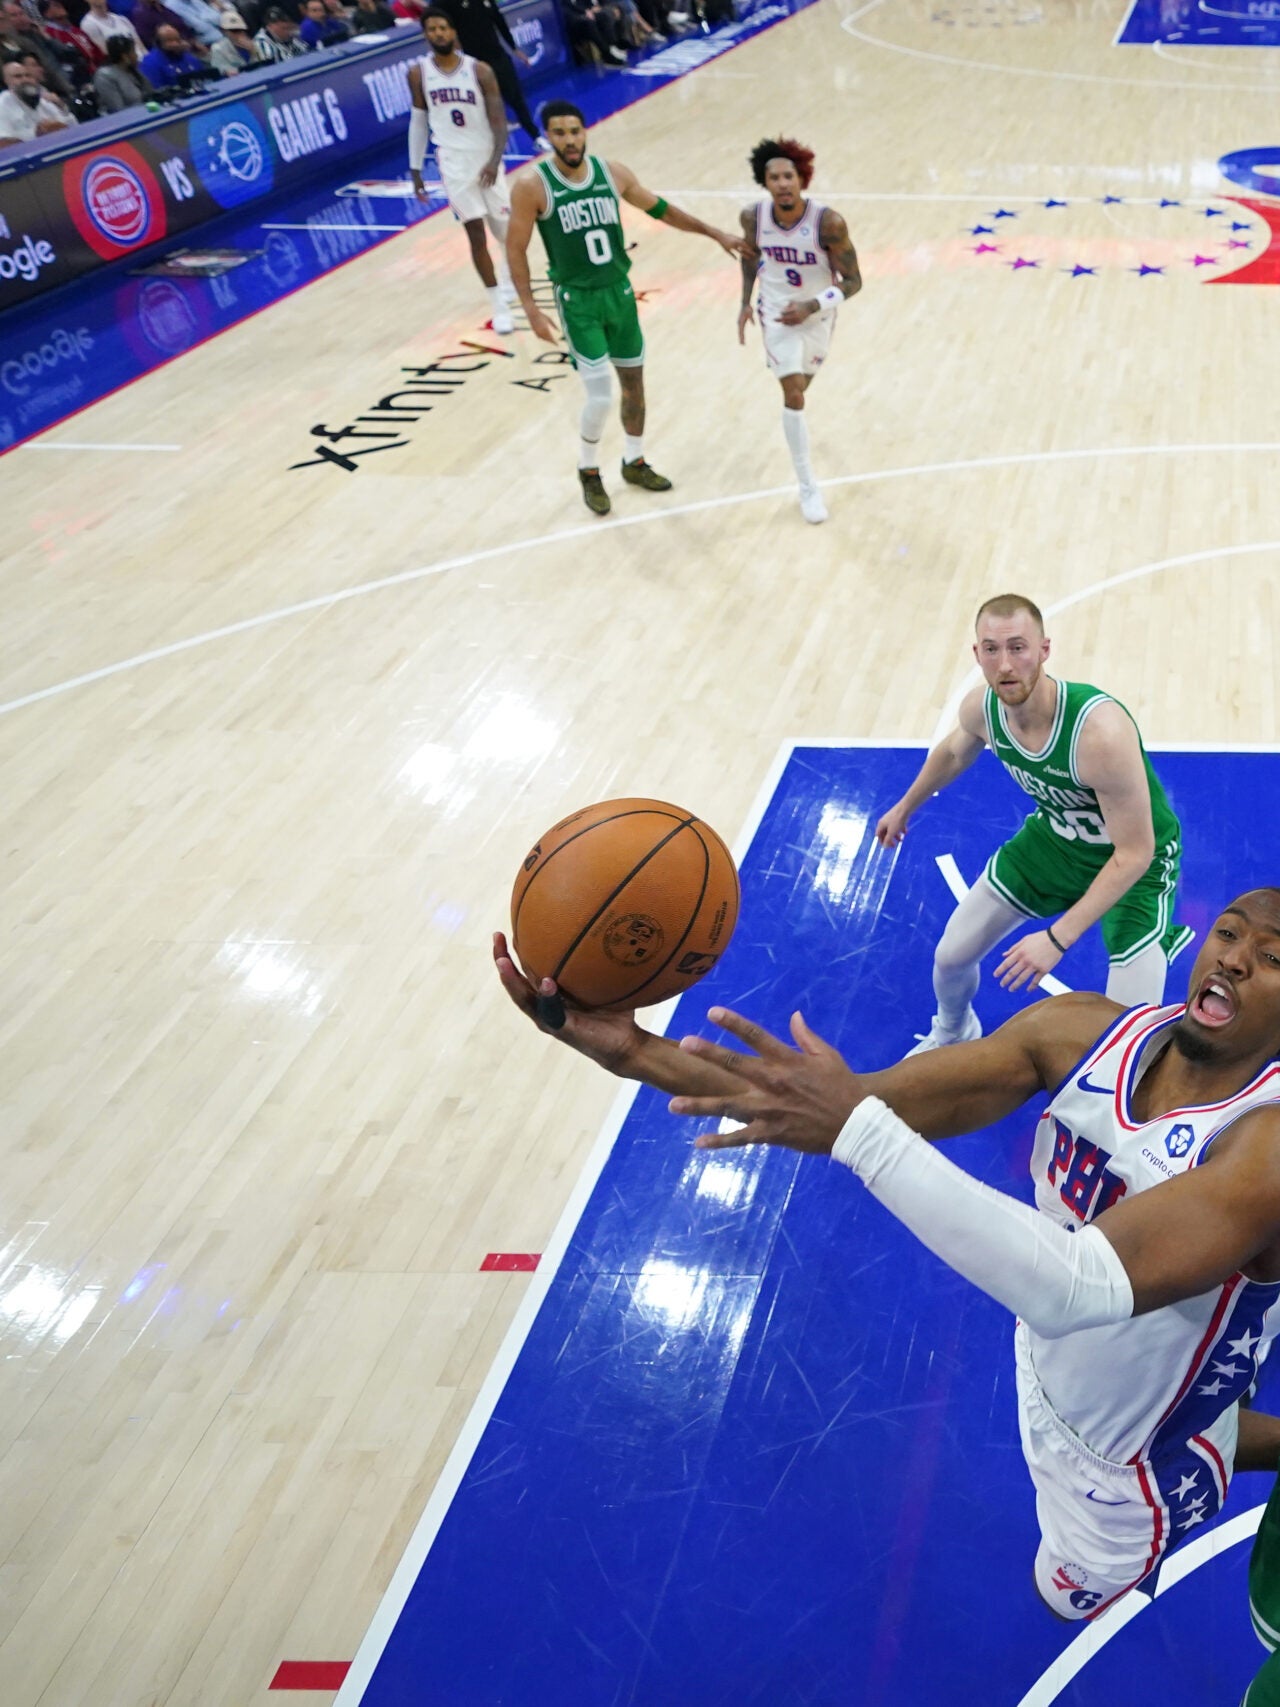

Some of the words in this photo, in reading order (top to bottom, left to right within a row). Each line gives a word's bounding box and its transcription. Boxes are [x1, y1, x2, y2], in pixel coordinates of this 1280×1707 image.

[429, 87, 477, 106] PHILA
[267, 92, 334, 163] GAME
[323, 87, 348, 141] 6
[451, 109, 466, 128] 8
[160, 156, 195, 201] VS
[557, 196, 619, 235] BOSTON
[0, 234, 56, 281] ogle
[584, 228, 613, 265] 0
[786, 268, 803, 288] 9
